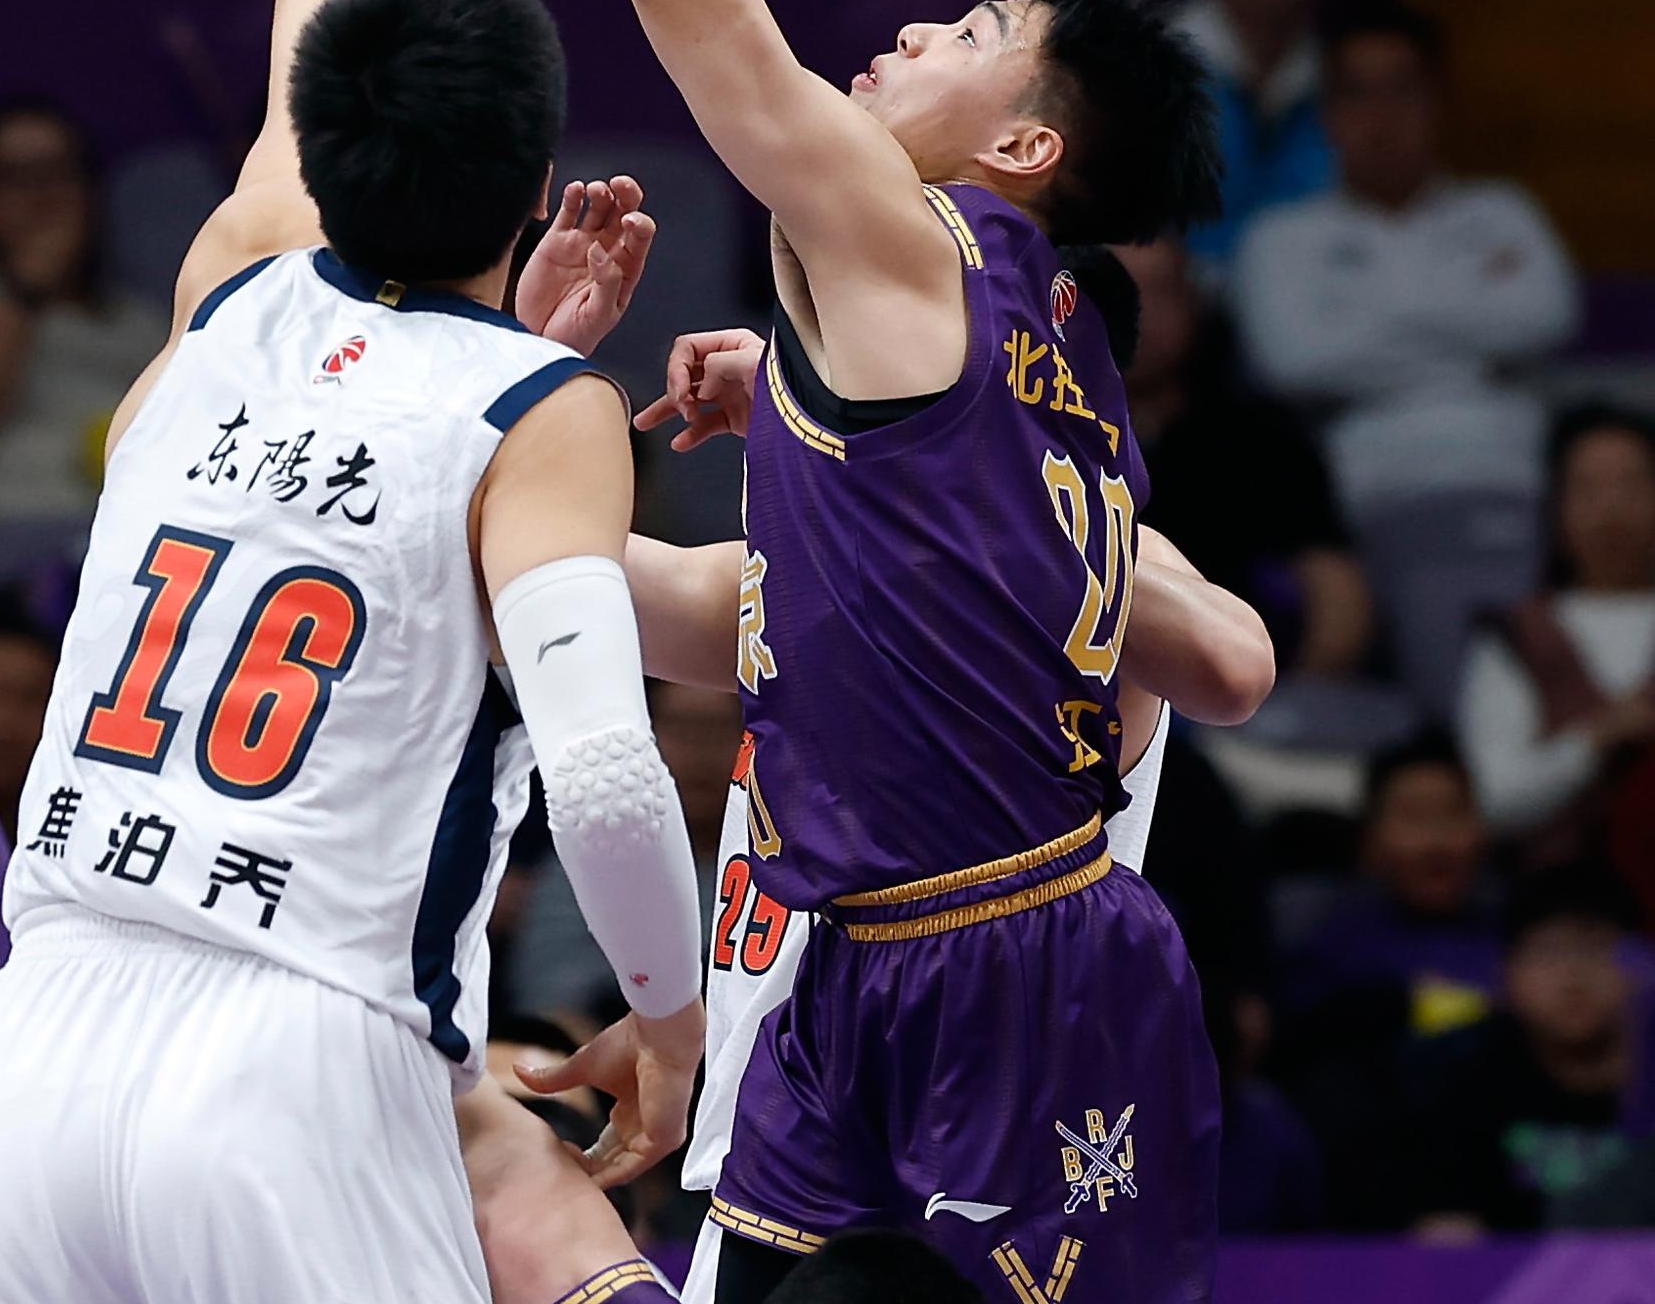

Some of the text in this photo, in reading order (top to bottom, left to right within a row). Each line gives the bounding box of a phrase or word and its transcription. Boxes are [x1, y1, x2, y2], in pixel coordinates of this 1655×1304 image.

[1002, 328, 1120, 458] 北控
[1041, 448, 1135, 686] 20
[74, 523, 368, 801] 16
[713, 853, 792, 977] 25
